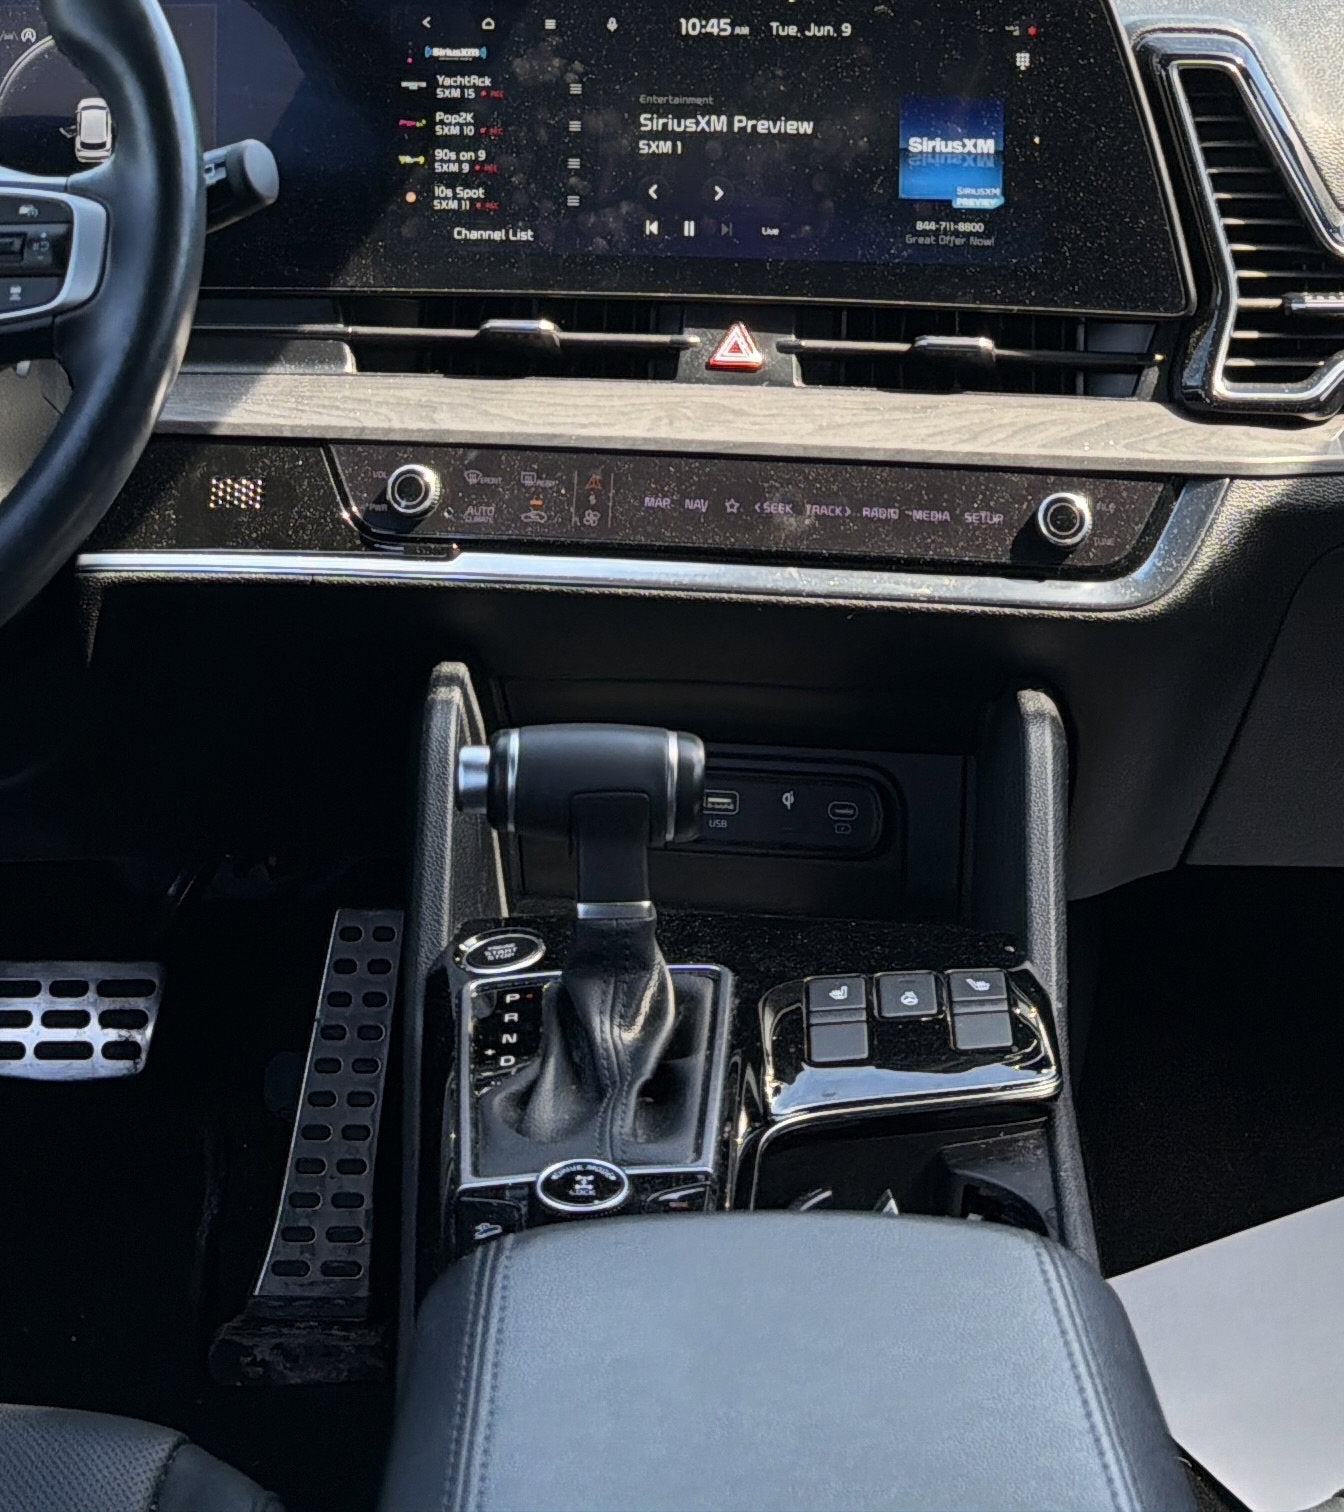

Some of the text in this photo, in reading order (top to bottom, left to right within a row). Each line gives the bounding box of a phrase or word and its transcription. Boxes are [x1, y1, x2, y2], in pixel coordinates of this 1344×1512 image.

[679, 17, 732, 36] 10:45
[734, 25, 750, 35] AM
[841, 22, 852, 36] 9
[436, 75, 492, 87] YachtRck
[436, 88, 460, 99] SXM
[464, 88, 476, 99] 15
[639, 94, 715, 105] Entertainment
[435, 112, 475, 124] Pop2K
[639, 113, 814, 135] SiriusXM Preview
[435, 125, 460, 136] SXM
[463, 125, 475, 136] 10
[638, 140, 683, 154] SXM 1
[908, 136, 996, 155] SiriusXM
[434, 149, 486, 161] 90s on 9
[434, 162, 459, 173] SXM
[461, 162, 470, 173] 9
[456, 187, 485, 200] Spot
[433, 199, 458, 211] SXM
[461, 199, 470, 211] 11
[453, 227, 534, 241] Channel List
[905, 234, 936, 246] Great
[372, 470, 389, 480] VOL
[644, 496, 670, 509] MAP
[684, 498, 709, 512] NAV
[465, 506, 495, 517] AUTO
[763, 501, 844, 517] SEEK TRACK
[862, 506, 900, 520] RADIO
[912, 509, 951, 523] MEDIA
[964, 511, 1004, 526] SETUP
[708, 819, 728, 828] USB
[506, 993, 521, 1003] P
[504, 1012, 519, 1022] R
[502, 1033, 517, 1043] N
[499, 1055, 516, 1066] D
